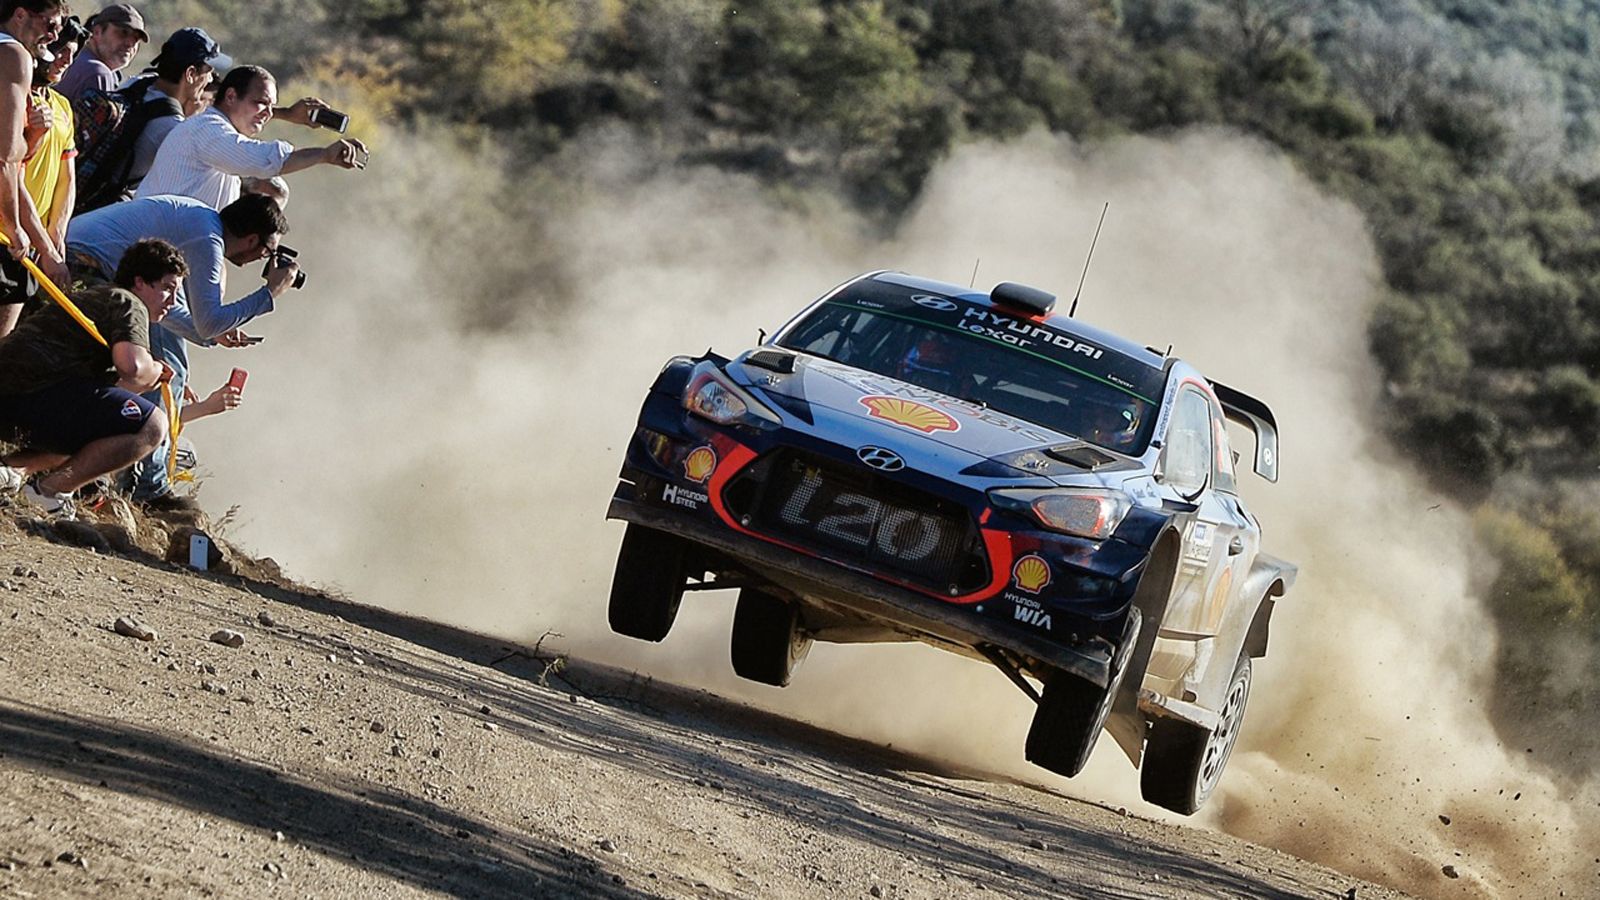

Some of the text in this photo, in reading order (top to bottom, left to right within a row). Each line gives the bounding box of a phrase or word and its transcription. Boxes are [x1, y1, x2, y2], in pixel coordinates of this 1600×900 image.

[957, 319, 1032, 348] Lexar
[963, 307, 1104, 360] HYUNDAI
[675, 496, 698, 509] STEEL
[677, 487, 709, 503] HYUNDAI
[1004, 592, 1041, 610] HYUNDAI
[1014, 604, 1052, 630] WIA
